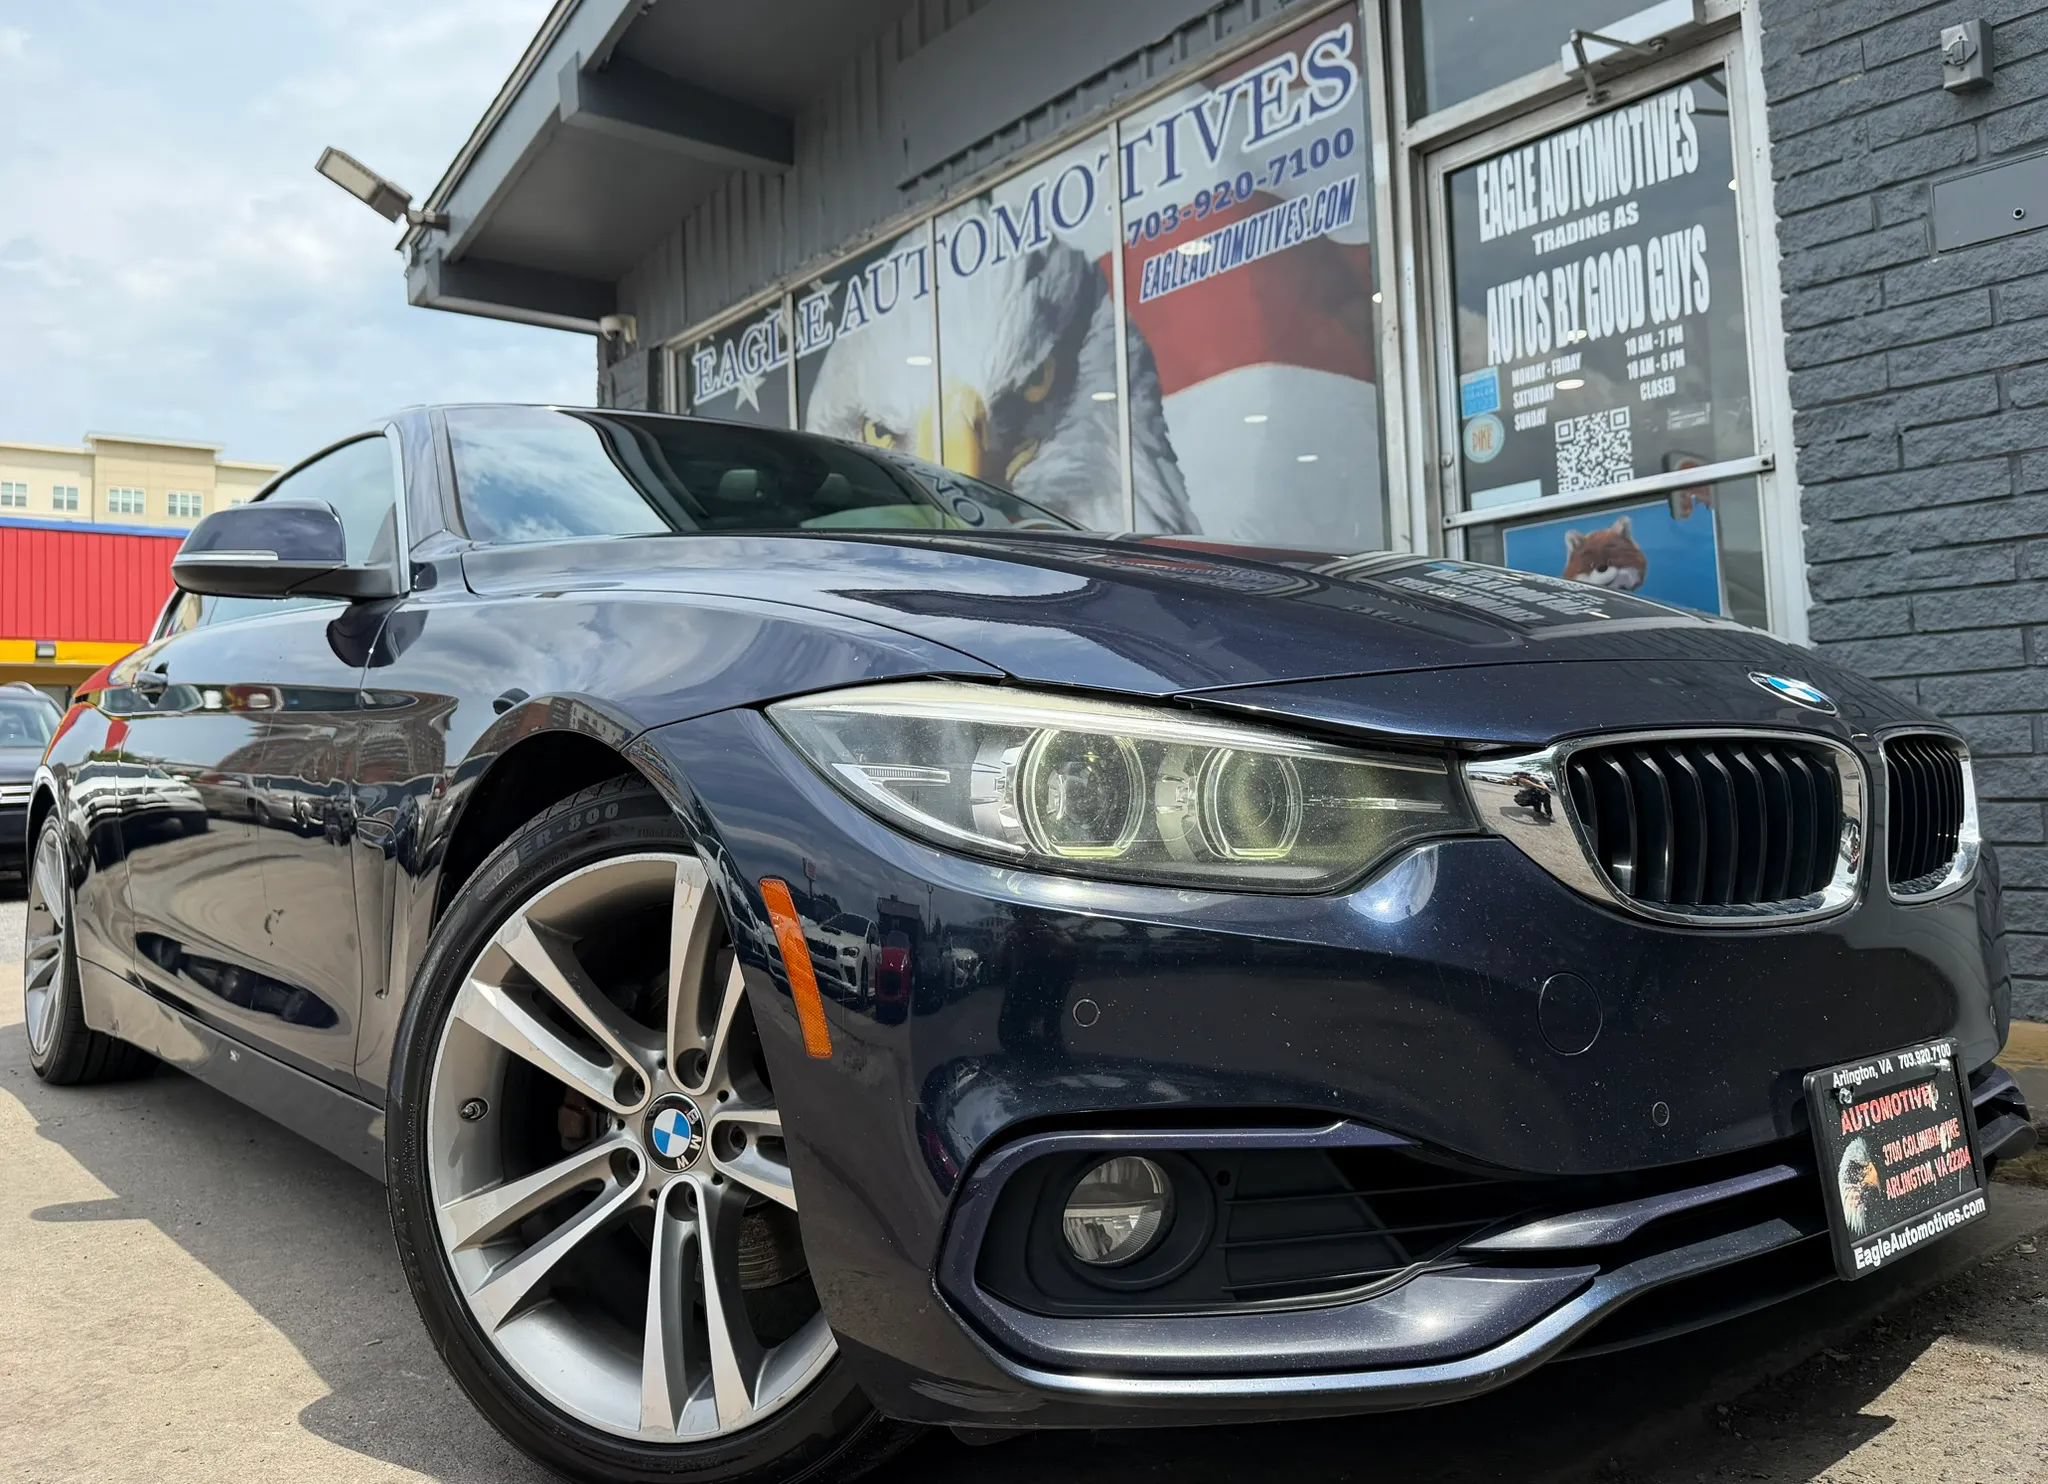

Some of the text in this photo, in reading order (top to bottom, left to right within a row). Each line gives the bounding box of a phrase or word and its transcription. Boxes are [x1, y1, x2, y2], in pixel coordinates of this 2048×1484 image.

[1128, 127, 1355, 247] 703-920-7100
[1476, 85, 1699, 243] EAGLE AUTOMOTIVES
[692, 22, 1360, 404] EAGLE AUTOMOTIVES
[1532, 201, 1640, 256] TRADING AS
[1140, 174, 1360, 303] EAGLEAUTOMOTIVES.COM
[1486, 224, 1711, 366] AUTOS BY GOOD GUYS
[1624, 336, 1637, 357] 10
[1637, 332, 1654, 354] AM
[1658, 328, 1665, 348] 7
[1667, 324, 1684, 346] PM
[1511, 361, 1547, 388] MONDAY
[1551, 352, 1582, 377] FRIDAY
[1626, 359, 1639, 381] 10
[1639, 356, 1656, 378] AM
[1661, 352, 1669, 372] 6
[1669, 348, 1686, 370] PM
[1513, 382, 1555, 410] SATURDAY
[1640, 375, 1676, 401] CLOSED
[1514, 407, 1547, 432] SUNDAY
[1832, 1043, 1952, 1089] Arlington, VA 703.920.7100
[674, 1108, 703, 1170] BMW
[1882, 1140, 1903, 1167] 3700
[1902, 1124, 1942, 1159] COLUMBIA
[1885, 1160, 1937, 1201] ARLINGTON,
[1933, 1155, 1949, 1178] VA
[1853, 1197, 1986, 1270] EagleAutomotives.com
